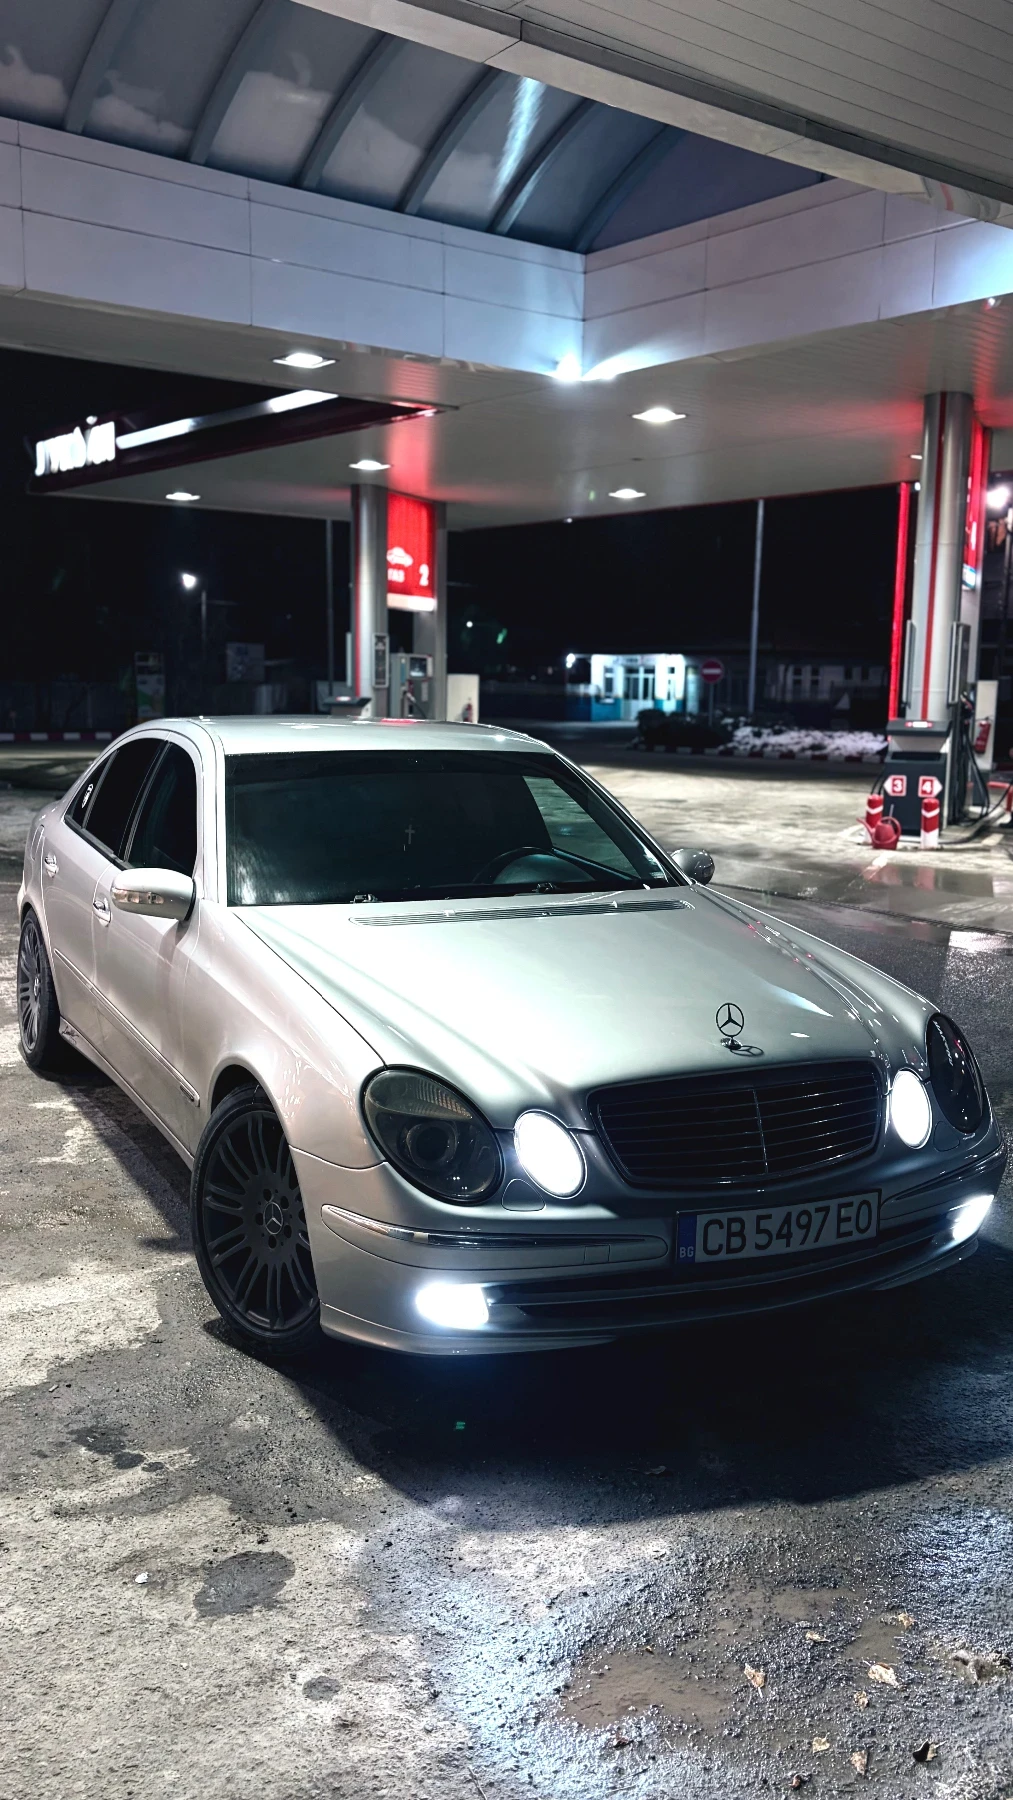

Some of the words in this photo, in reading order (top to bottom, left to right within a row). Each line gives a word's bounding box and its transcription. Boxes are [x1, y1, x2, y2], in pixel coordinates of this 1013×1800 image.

[419, 564, 429, 586] 2
[893, 779, 902, 792] 3
[921, 780, 932, 793] 4
[702, 1217, 747, 1256] CB
[754, 1206, 831, 1251] 5497
[679, 1246, 694, 1258] BG
